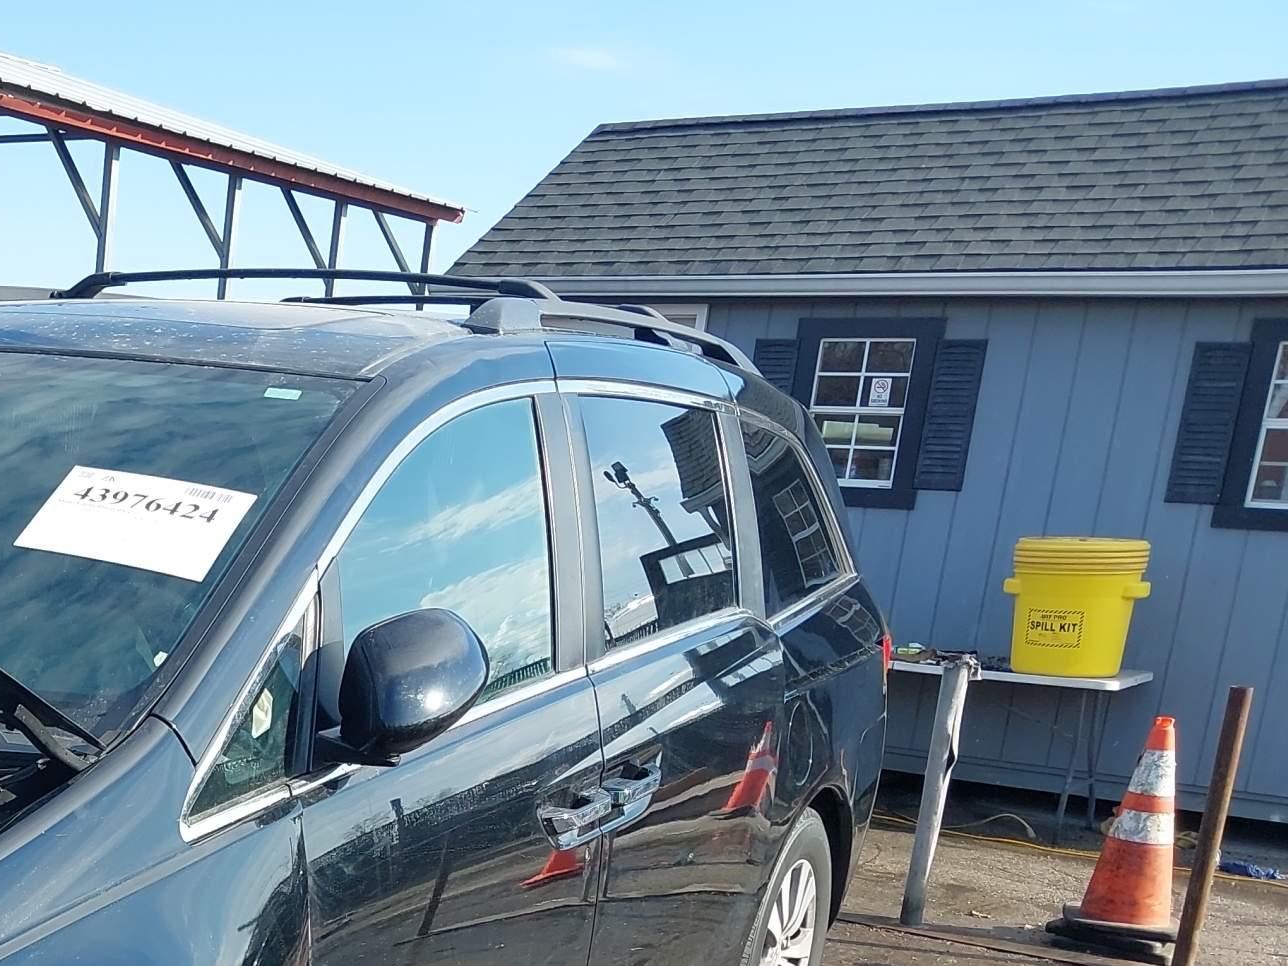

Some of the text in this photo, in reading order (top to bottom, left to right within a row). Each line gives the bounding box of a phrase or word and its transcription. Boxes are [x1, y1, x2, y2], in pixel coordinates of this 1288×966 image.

[73, 486, 219, 523] 43976424
[1030, 620, 1078, 633] SPILL KIT
